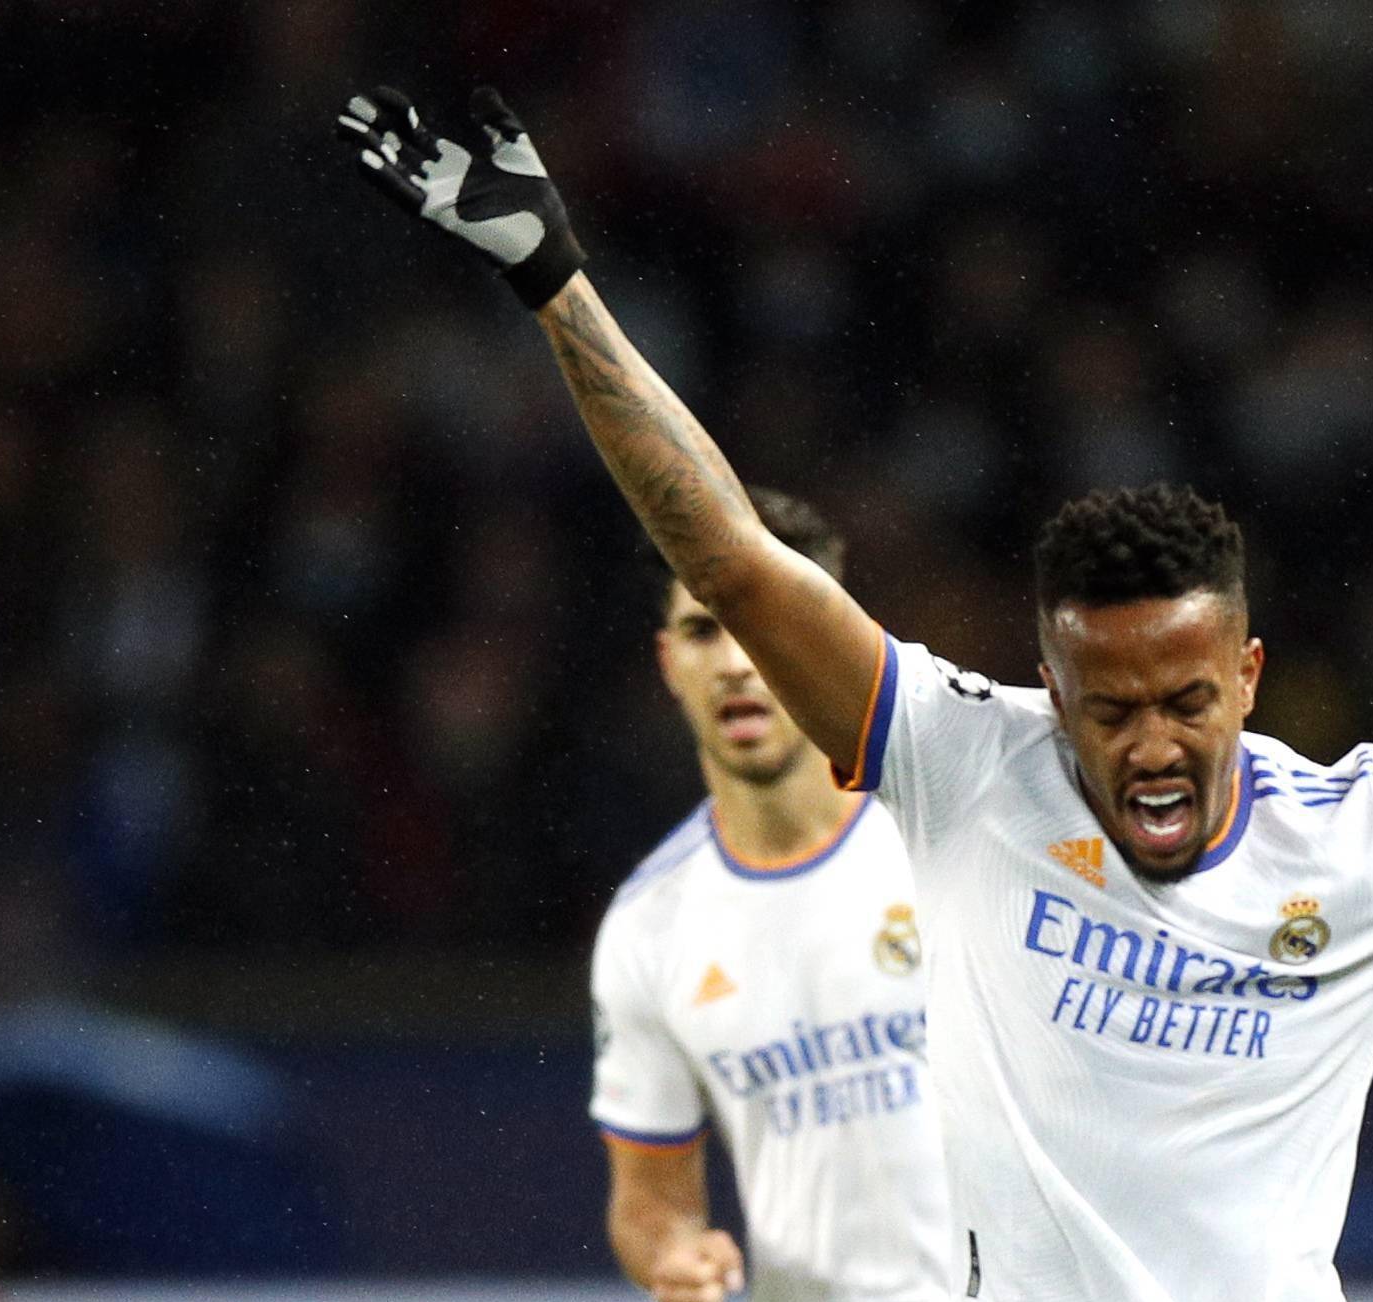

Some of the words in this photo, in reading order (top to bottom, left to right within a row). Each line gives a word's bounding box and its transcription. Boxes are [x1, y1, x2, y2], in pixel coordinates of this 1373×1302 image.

[709, 1006, 927, 1098] Emirate
[1052, 977, 1123, 1035] FLY
[1130, 995, 1272, 1059] BETTER
